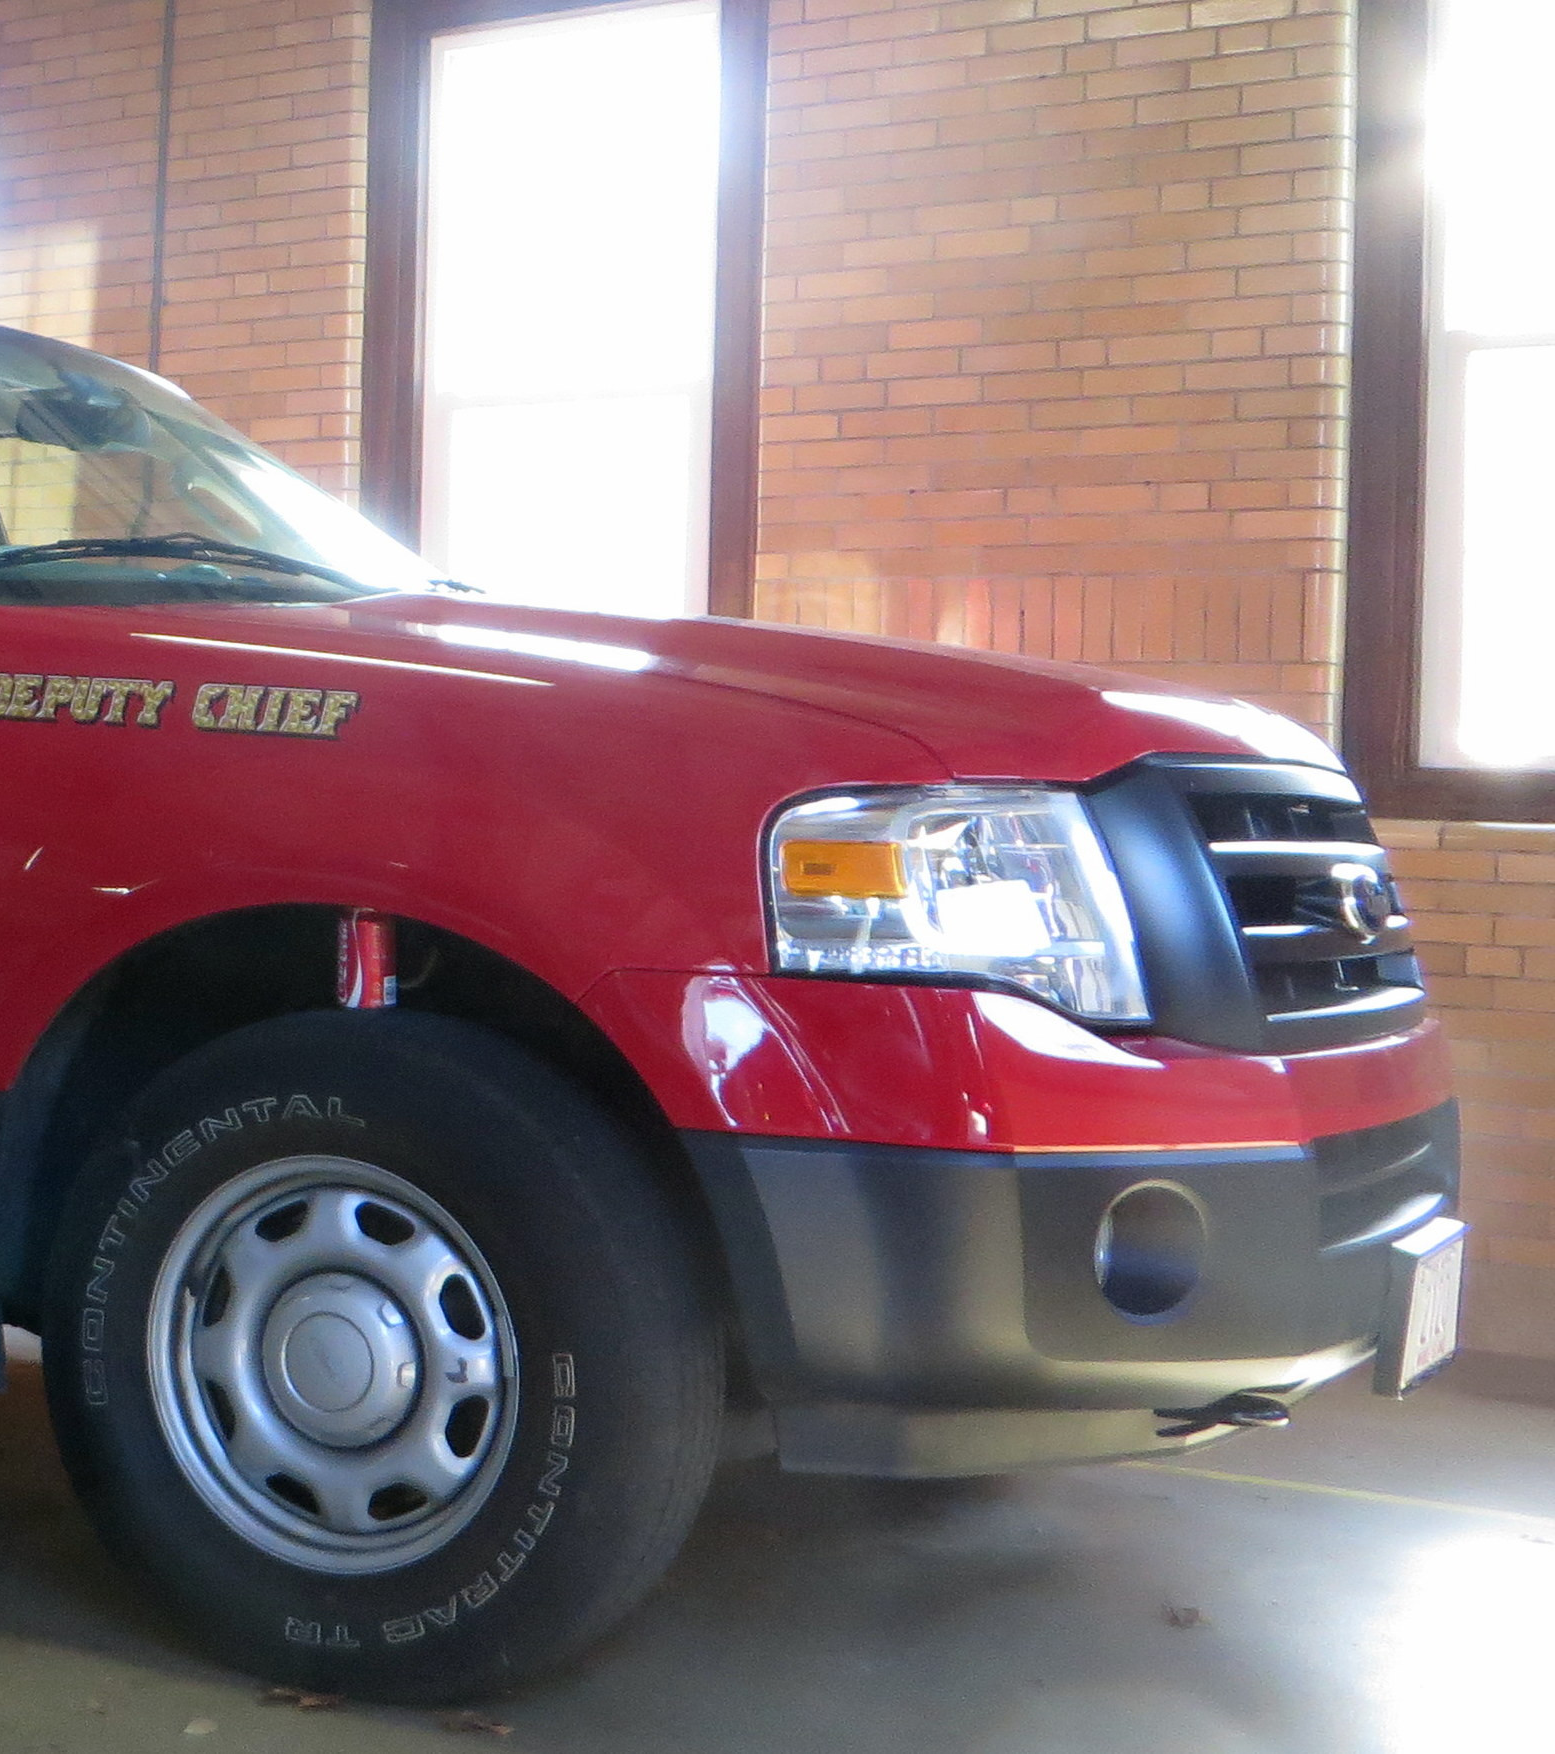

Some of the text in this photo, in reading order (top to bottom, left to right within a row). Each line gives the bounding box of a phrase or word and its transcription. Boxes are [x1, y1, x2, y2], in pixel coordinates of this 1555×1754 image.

[190, 682, 361, 740] CHIEF
[79, 1094, 369, 1407] CONTINENTAL
[284, 1352, 576, 1649] CONTITRAC TR
